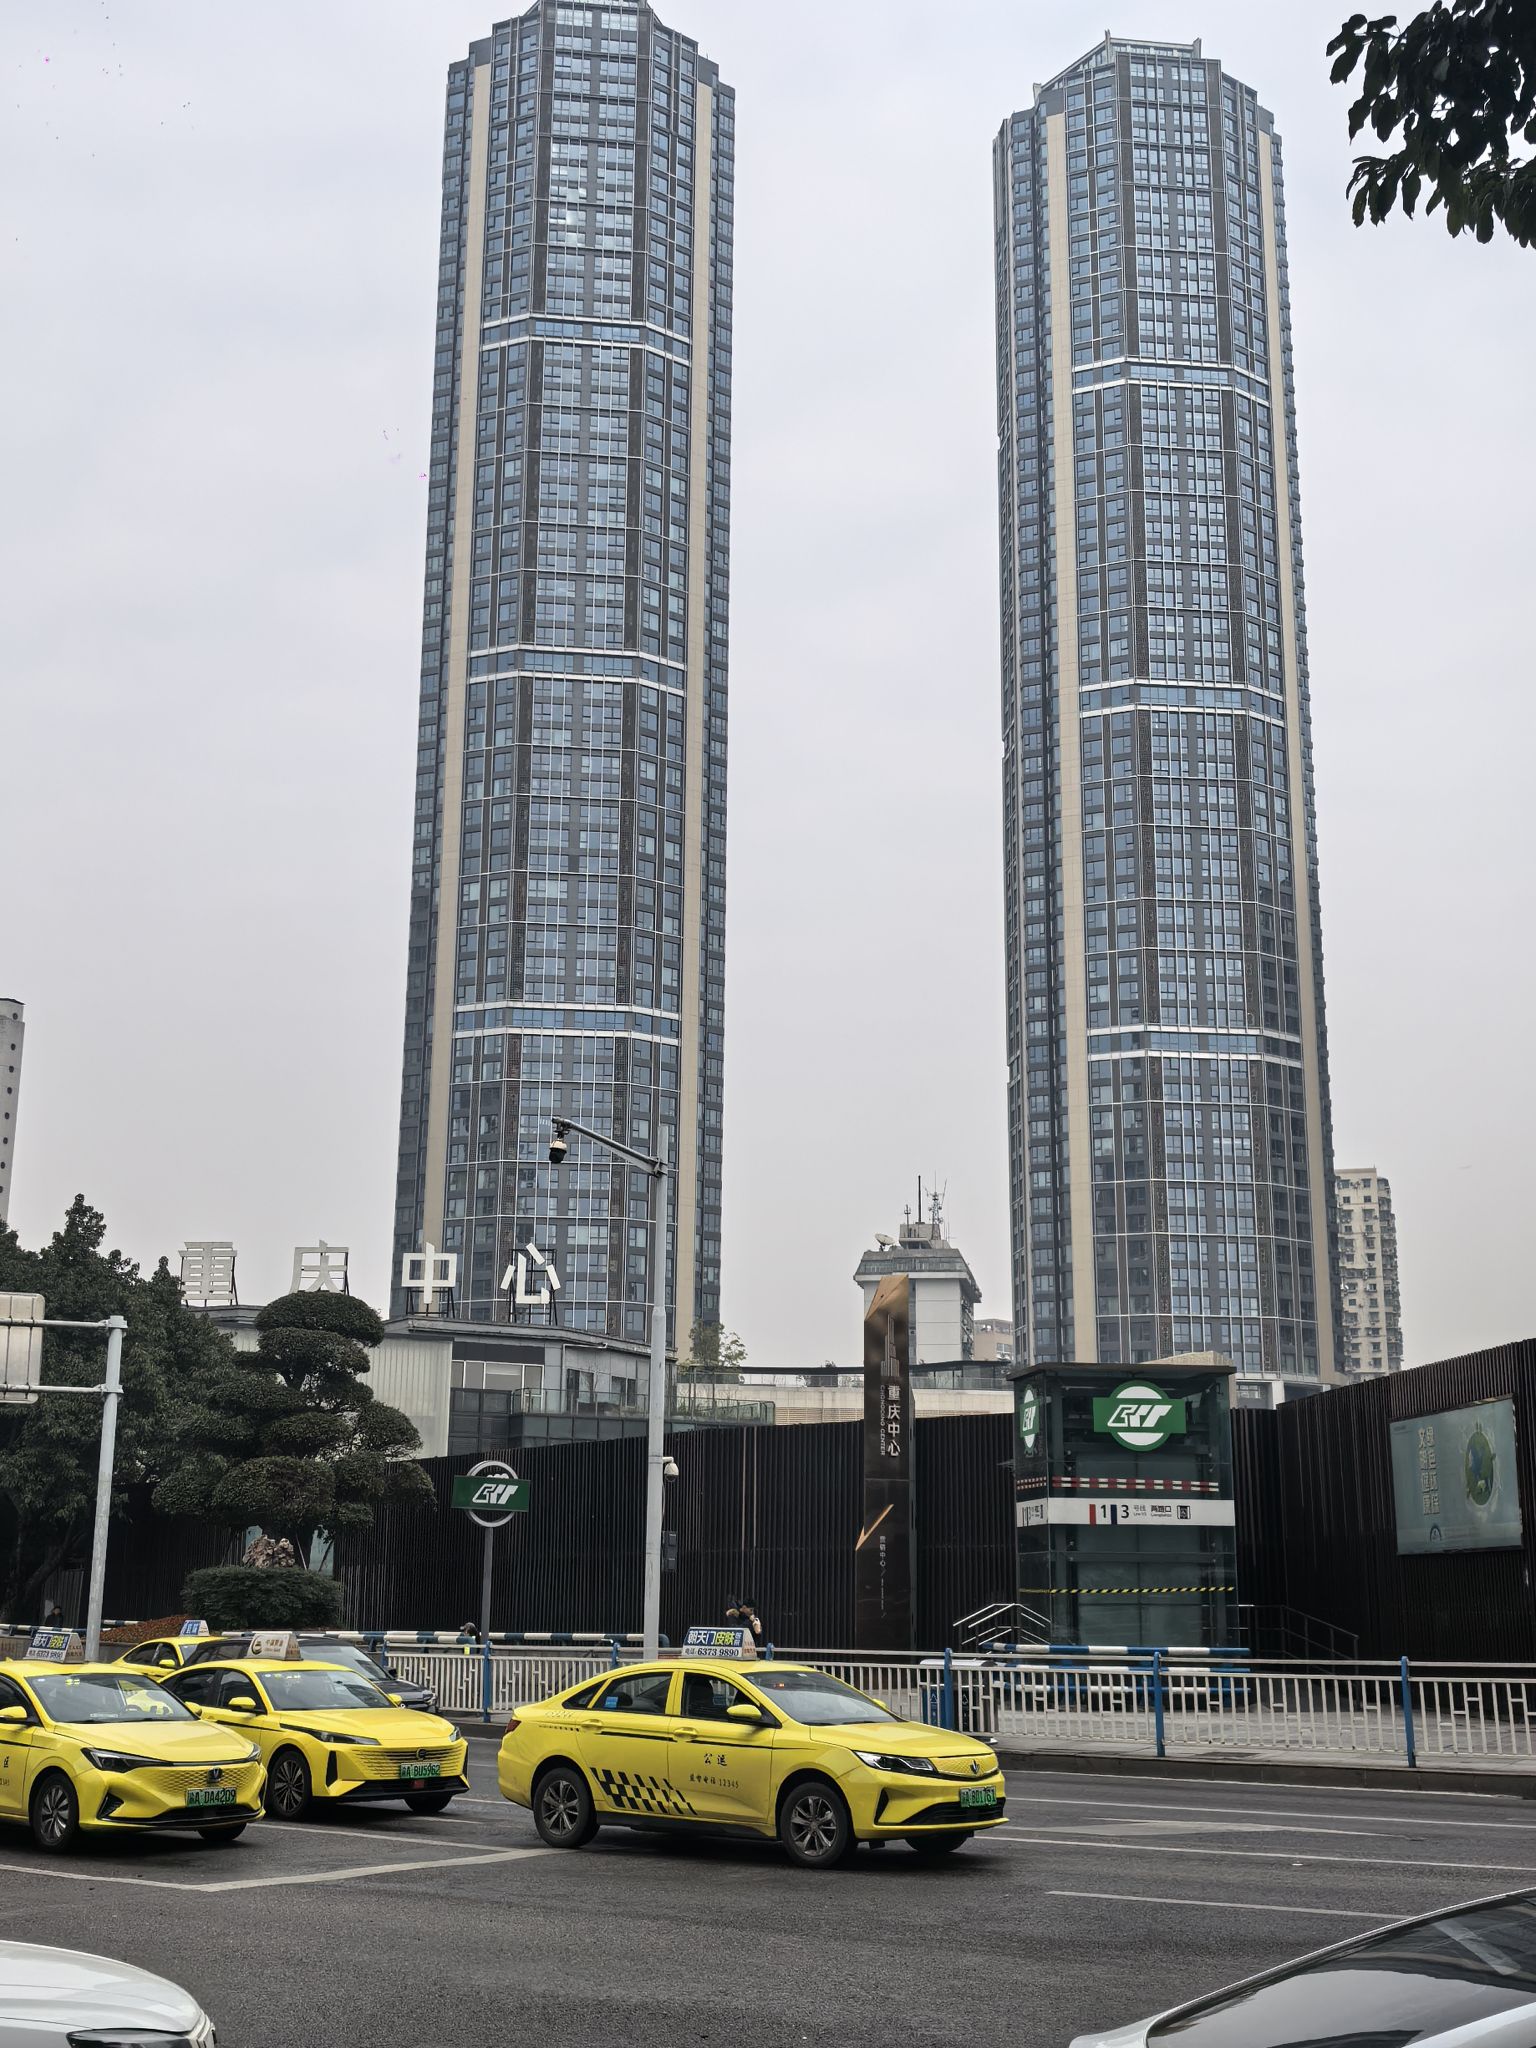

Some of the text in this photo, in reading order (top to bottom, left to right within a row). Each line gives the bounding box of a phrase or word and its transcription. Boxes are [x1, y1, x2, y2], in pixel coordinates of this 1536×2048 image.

[178, 1240, 561, 1304] 重庆中心
[888, 1385, 901, 1456] 重庆中心
[1100, 1504, 1107, 1519] 1
[1121, 1504, 1130, 1519] 3
